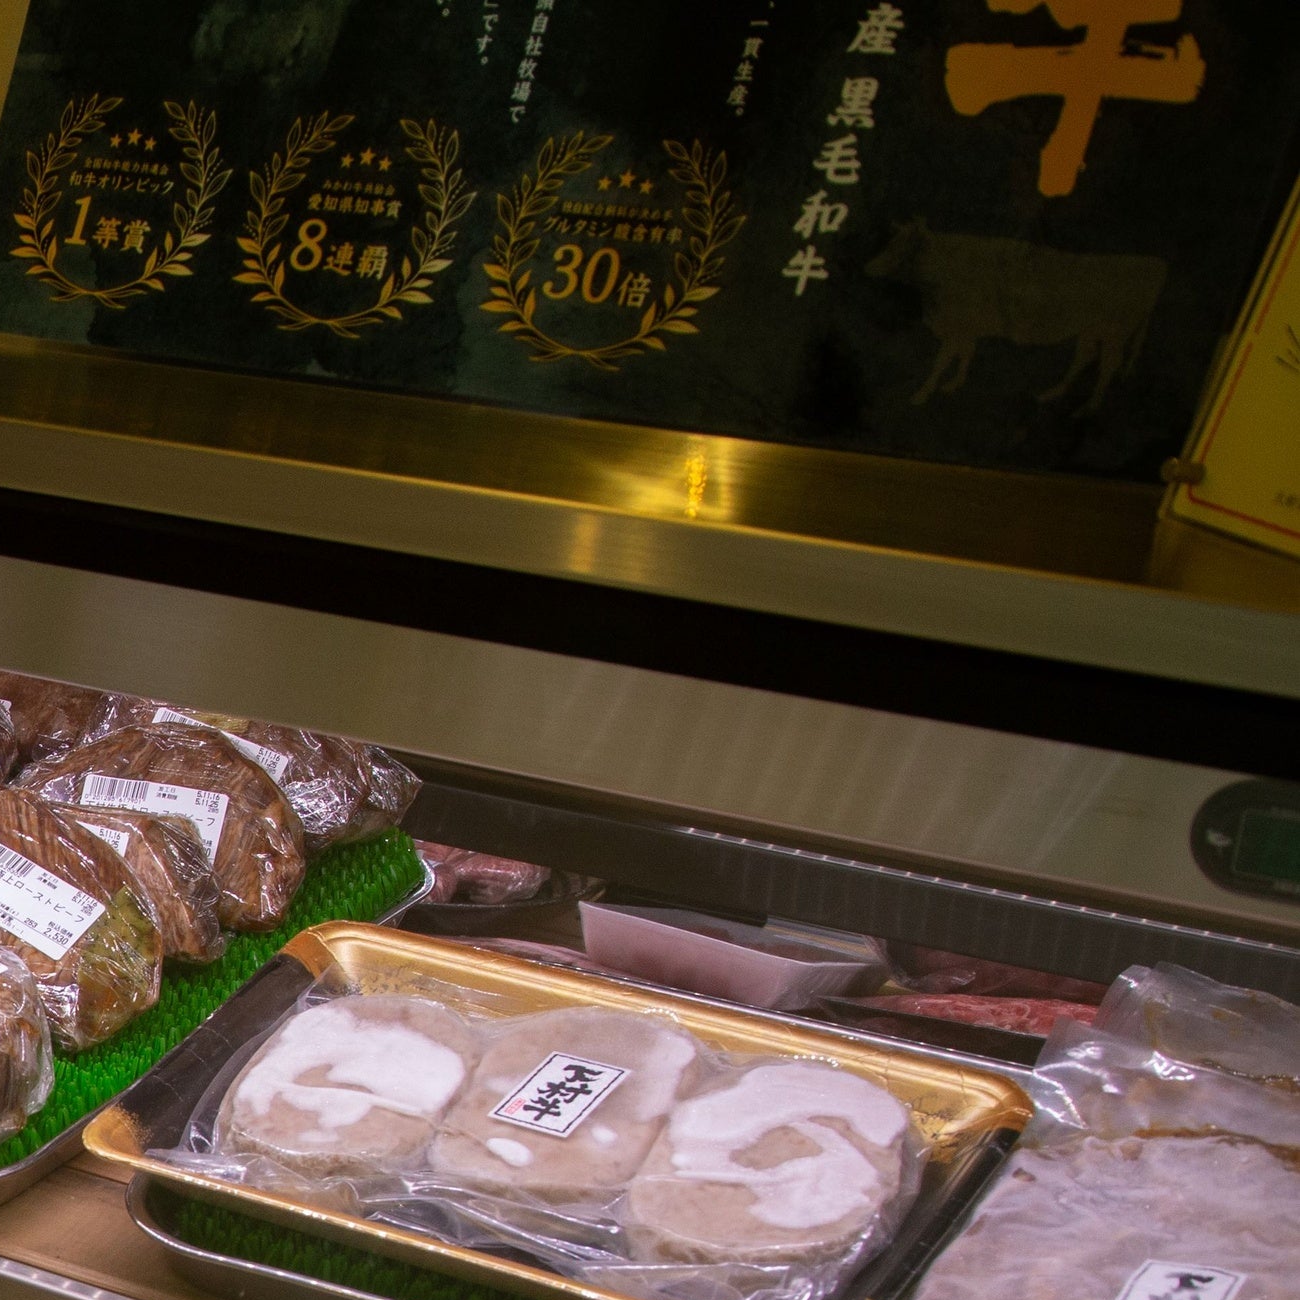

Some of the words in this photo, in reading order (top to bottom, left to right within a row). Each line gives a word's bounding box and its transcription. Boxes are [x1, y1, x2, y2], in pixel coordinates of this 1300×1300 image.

[69, 169, 175, 196] 和牛オリンピック
[307, 193, 402, 219] 愛知県知事賞
[543, 214, 684, 244] グルタミン酸含有率
[195, 798, 219, 809] 5.11.25
[197, 791, 220, 801] 5.11.16
[43, 928, 69, 946] 2,530
[523, 1064, 604, 1121] 下村牛
